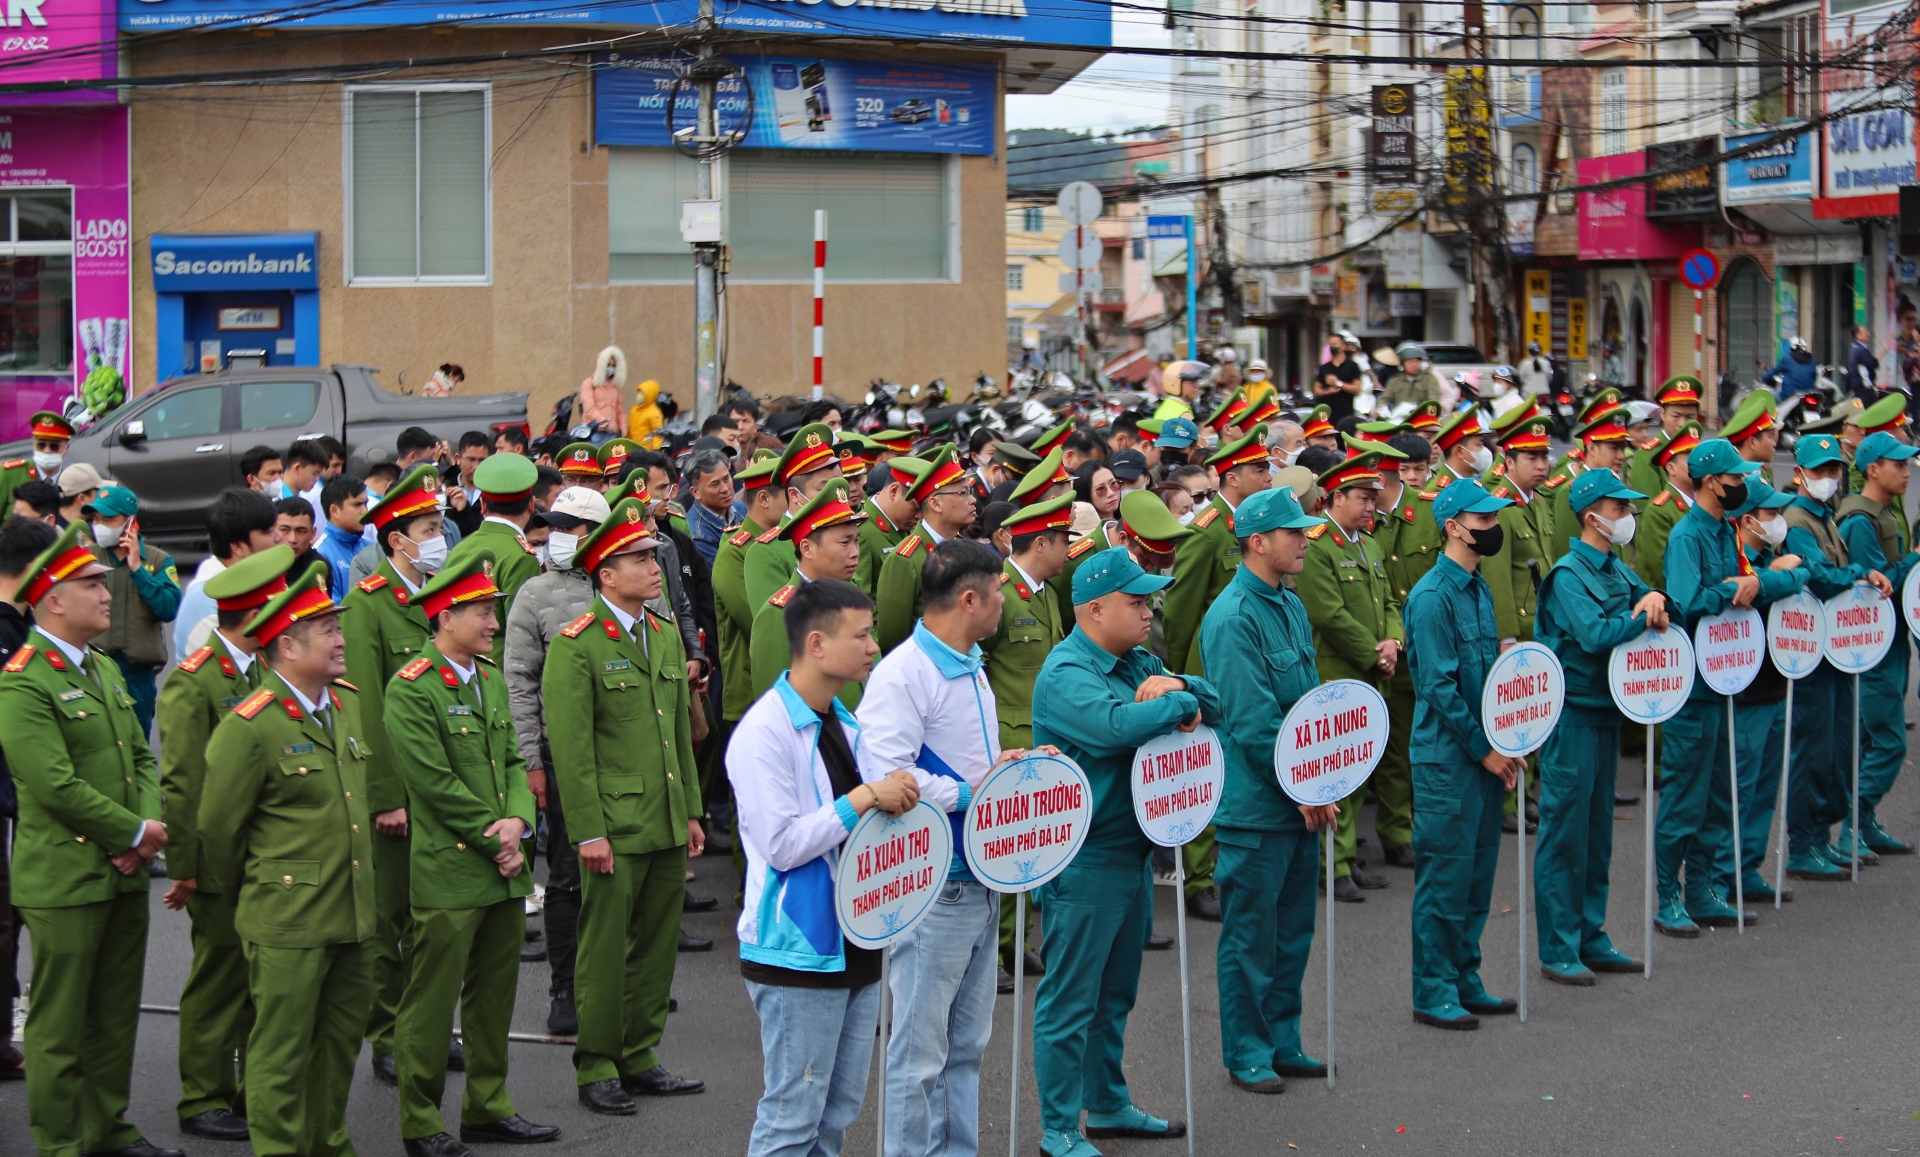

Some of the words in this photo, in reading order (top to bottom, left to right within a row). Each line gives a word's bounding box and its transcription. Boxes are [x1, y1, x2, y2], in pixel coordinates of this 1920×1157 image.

[638, 93, 665, 109] NỐI
[856, 98, 884, 113] 320
[76, 218, 127, 241] LADO
[76, 240, 127, 258] BOOST
[154, 251, 313, 275] Sacombank
[235, 311, 264, 324] ATM
[1573, 303, 1584, 355] HOTEL
[1781, 607, 1808, 631] PHƯỜNG
[1809, 614, 1815, 632] 9
[1836, 604, 1871, 628] PHƯỜNG
[1873, 606, 1879, 623] 8
[1709, 618, 1739, 645] PHƯỜNG
[1740, 620, 1750, 639] 10
[1627, 645, 1666, 672] PHƯỜNG
[1669, 648, 1679, 667] 11
[1705, 653, 1724, 673] THÀNH
[1725, 648, 1737, 669] PHỐ
[1737, 648, 1745, 667] ĐÀ
[1745, 649, 1756, 668] LẠT
[1497, 673, 1534, 706] PHƯỜNG
[1537, 671, 1548, 694] 12
[1623, 679, 1645, 696] THÀNH
[1647, 674, 1660, 694] PHỐ
[1661, 675, 1671, 693] ĐÀ
[1672, 676, 1683, 693] LẠT
[1295, 718, 1312, 750] XÃ
[1314, 713, 1331, 743] TÀ
[1334, 705, 1368, 737] NUNG
[1494, 711, 1515, 732] THÀNH
[1516, 702, 1529, 725] PHỐ
[1530, 702, 1539, 722] ĐÀ
[1540, 701, 1552, 721] LẠT
[1141, 753, 1155, 785] XÃ
[1156, 749, 1184, 782] TRẠM
[1186, 740, 1211, 772] HÀNH
[1291, 759, 1321, 785] THÀNH
[1323, 745, 1342, 775] PHỐ
[1343, 743, 1355, 768] ĐÀ
[1357, 740, 1374, 764] LẠT
[976, 797, 993, 831] XÃ
[996, 790, 1030, 827] XUÂN
[1033, 780, 1082, 818] TRƯỜNG
[1144, 795, 1170, 821] THÀNH
[1171, 782, 1187, 813] PHỐ
[1188, 782, 1199, 808] ĐÀ
[1199, 781, 1213, 807] LẠT
[856, 844, 871, 883] XÃ
[874, 834, 905, 876] XUÂN
[908, 826, 930, 861] THỌ
[984, 836, 1015, 861] THÀNH
[1017, 824, 1037, 853] PHỐ
[1038, 824, 1052, 848] ĐÀ
[1054, 823, 1072, 846] LẠT
[853, 890, 881, 918] THÀNH
[882, 871, 901, 905] PHỐ
[902, 869, 914, 896] ĐÀ
[917, 865, 934, 892] LẠT
